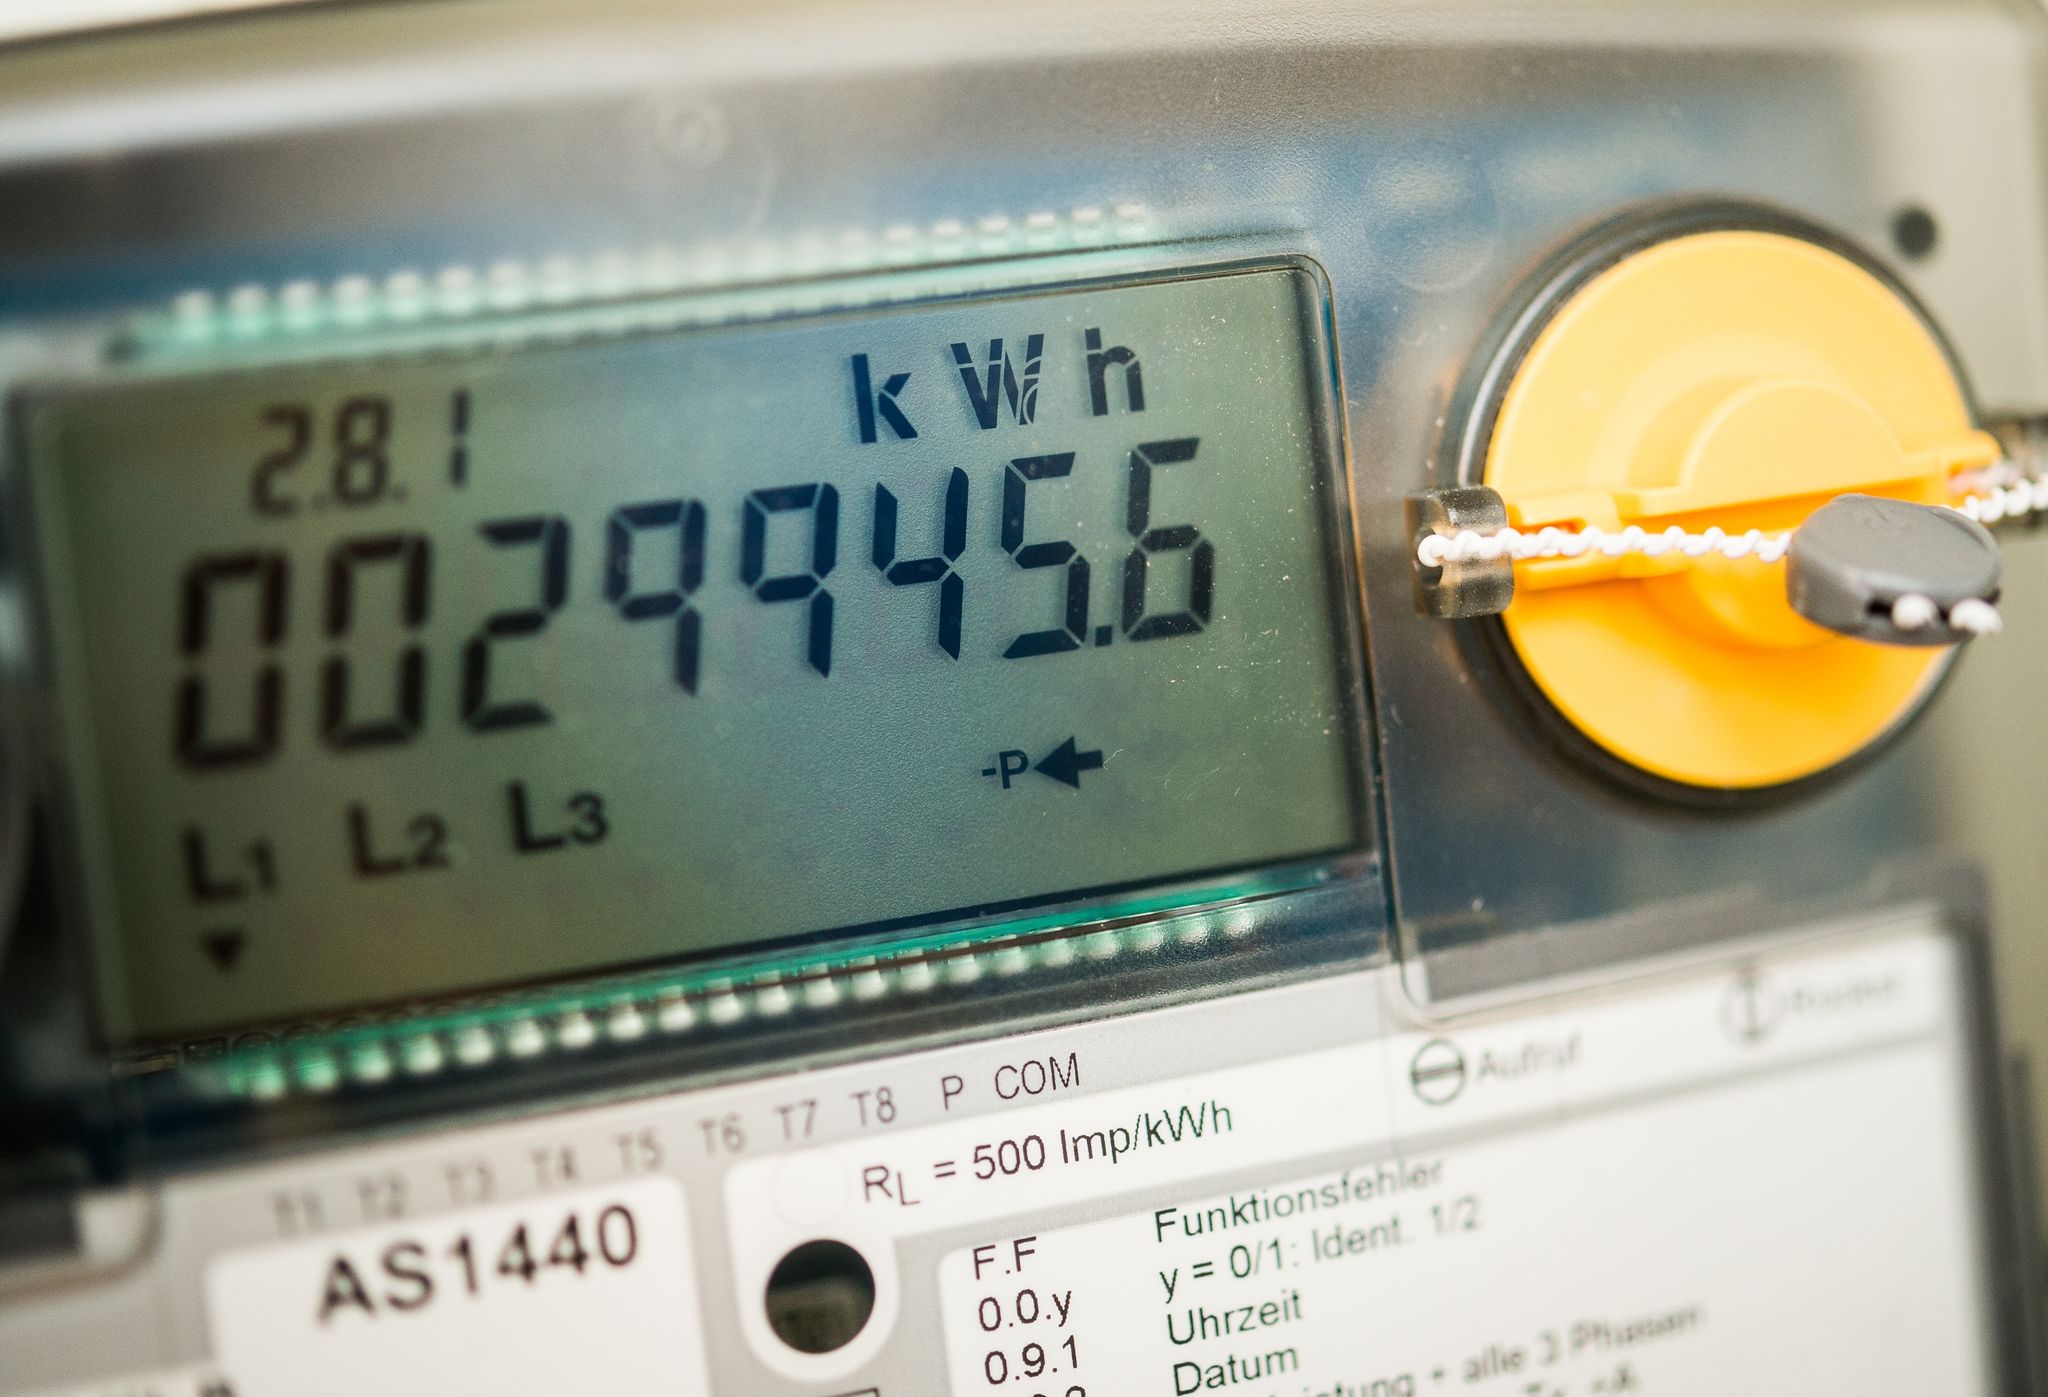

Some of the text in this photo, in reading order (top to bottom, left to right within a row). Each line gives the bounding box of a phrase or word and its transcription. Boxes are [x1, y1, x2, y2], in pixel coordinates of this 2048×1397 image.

[851, 328, 1146, 443] kWh
[173, 437, 1215, 772] 0029945.6
[181, 779, 608, 908] L1 L2 L3
[532, 1144, 579, 1189] T4
[616, 1129, 664, 1173] T5
[698, 1114, 746, 1155] T6
[774, 1100, 819, 1141] T7
[851, 1087, 897, 1129] T8
[940, 1075, 965, 1111] P
[994, 1052, 1080, 1100] COM
[862, 1165, 920, 1206] RL
[972, 1134, 1046, 1180] 500
[1060, 1101, 1233, 1164] Imp/kWh
[316, 1205, 638, 1323] AS1440
[972, 1159, 1443, 1280] F.F Funktionsfehler
[978, 1288, 1072, 1332] 0.0.y
[1159, 1268, 1178, 1304] y
[985, 1289, 1303, 1385] 0.9.1 Uhrzeit
[1173, 1348, 1299, 1396] Datum
